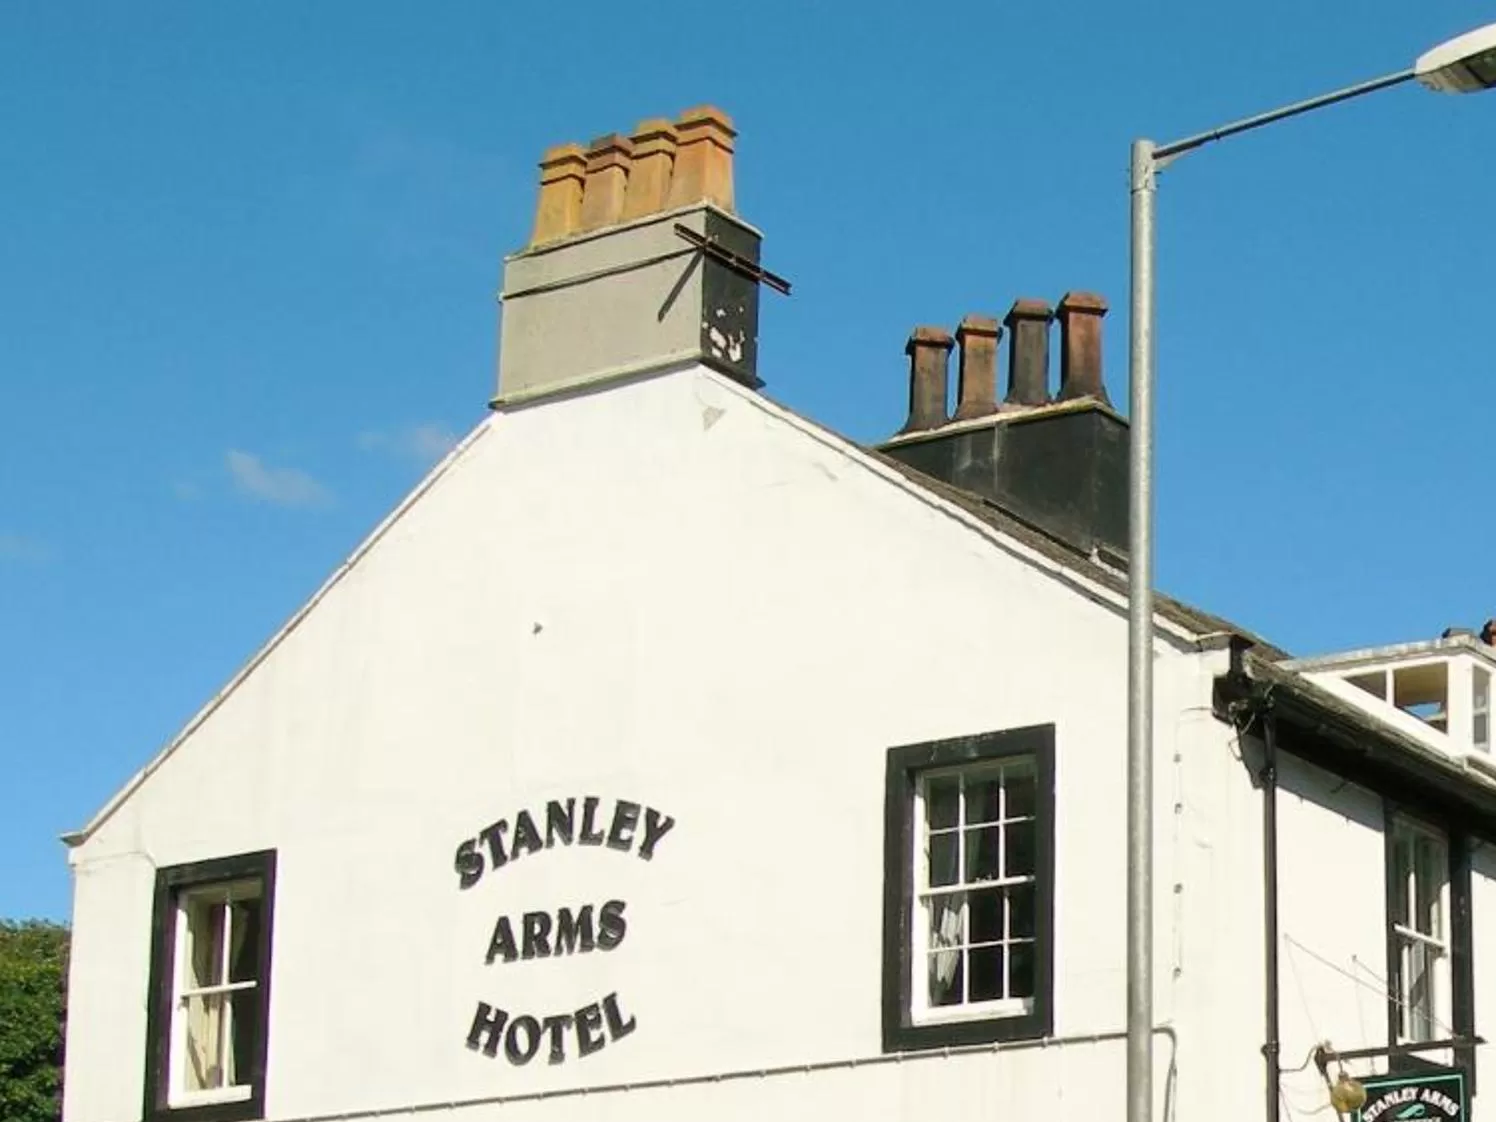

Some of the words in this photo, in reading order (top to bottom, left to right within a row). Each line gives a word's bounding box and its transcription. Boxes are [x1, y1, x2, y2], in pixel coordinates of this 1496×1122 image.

[454, 797, 675, 890] STANLEY
[484, 899, 627, 965] ARMS
[465, 992, 637, 1067] HOTEL
[1420, 1088, 1460, 1116] ARMS
